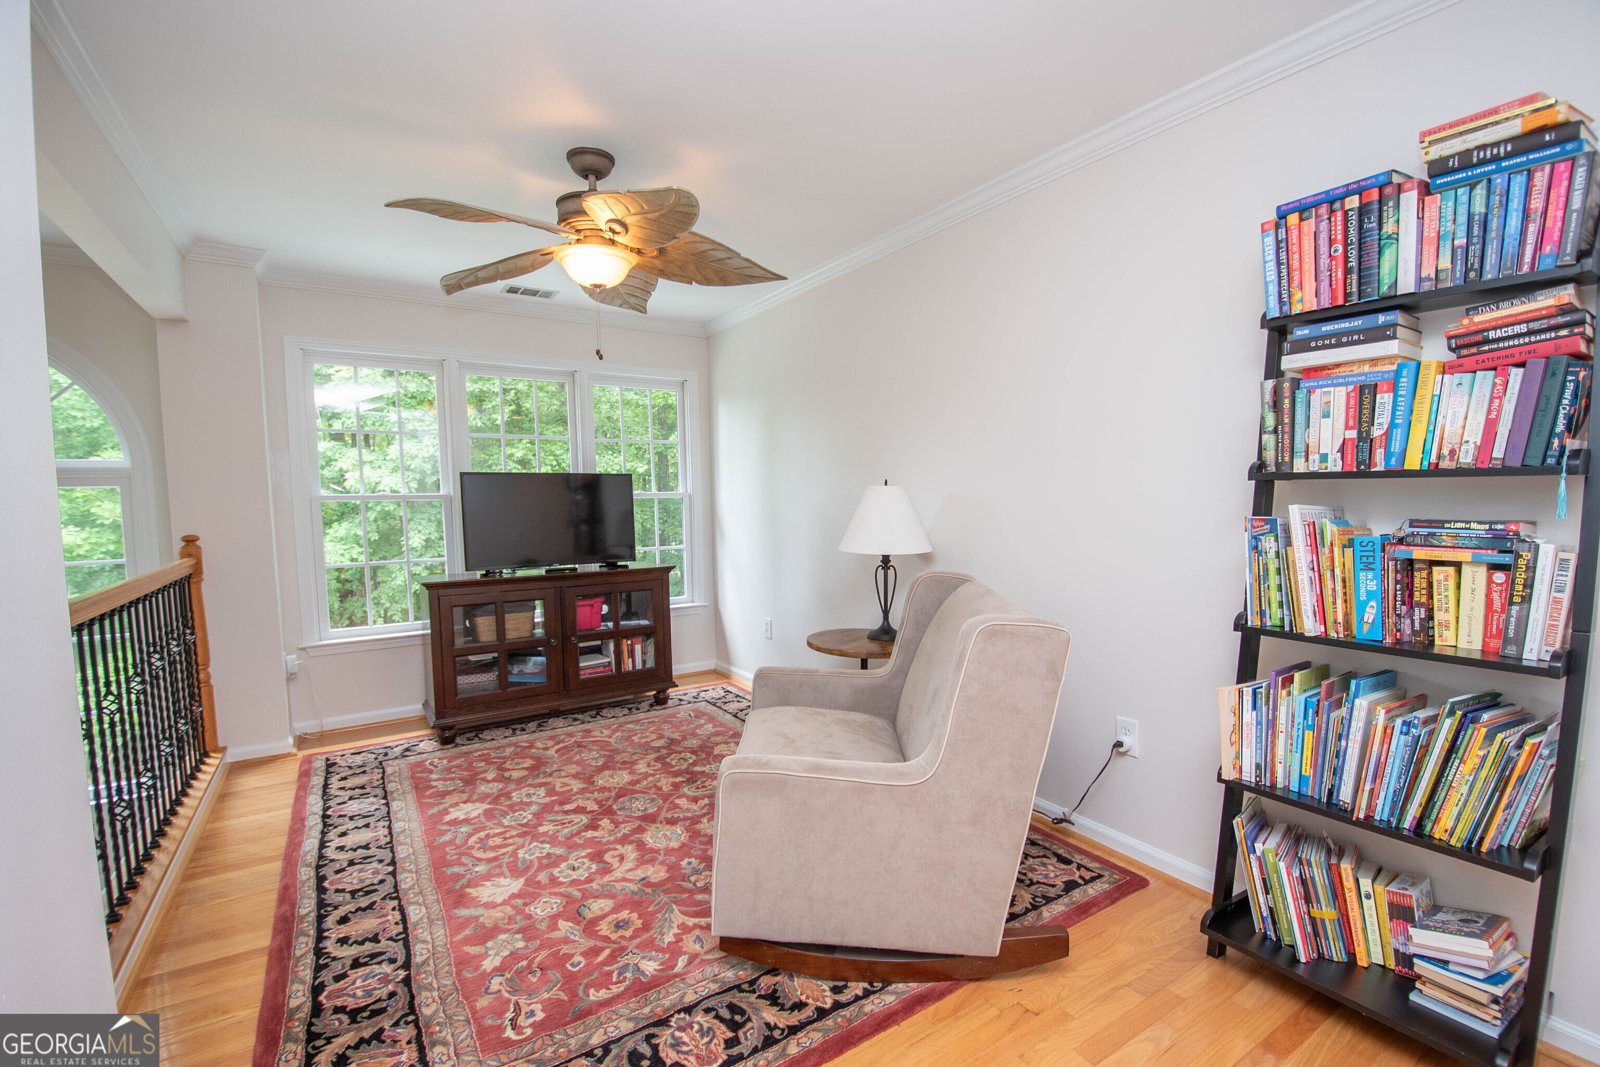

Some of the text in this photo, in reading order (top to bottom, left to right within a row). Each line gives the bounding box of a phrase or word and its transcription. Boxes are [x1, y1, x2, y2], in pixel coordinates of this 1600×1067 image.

[1502, 148, 1560, 167] BEATRIZ WILLIAMS
[1360, 177, 1376, 186] Stars
[1437, 173, 1466, 184] HUSBANDS
[1473, 165, 1496, 174] LOVERS
[1301, 194, 1325, 204] Williams
[1531, 171, 1544, 208] HOPELESS
[1264, 237, 1274, 281] BEACH READ
[1479, 302, 1498, 314] DAN
[1499, 296, 1530, 310] BROWN
[1322, 320, 1362, 331] MOCKINGJAY
[1489, 324, 1528, 340] RACERS
[1531, 332, 1556, 342] GAMES
[1476, 349, 1538, 365] CATCHING FIRE
[1333, 376, 1366, 384] GIRLFRIEND
[1398, 378, 1408, 395] HEIR
[1563, 382, 1573, 399] STUDY
[1361, 394, 1370, 431] OVERSEAS
[1376, 402, 1386, 431] ROYAL WE
[1395, 397, 1405, 424] AFFAIR
[1555, 405, 1569, 433] Charlotte
[1359, 540, 1376, 572] STEM
[1558, 558, 1571, 572] MARK
[1367, 580, 1376, 590] 30
[1513, 552, 1531, 603] Pandemia
[1553, 579, 1567, 594] LEVIN
[1548, 596, 1564, 622] AMERICAN
[1508, 606, 1520, 638] Berenson
[1448, 758, 1460, 781] CHARLIE
[1352, 914, 1361, 947] COMPANION
